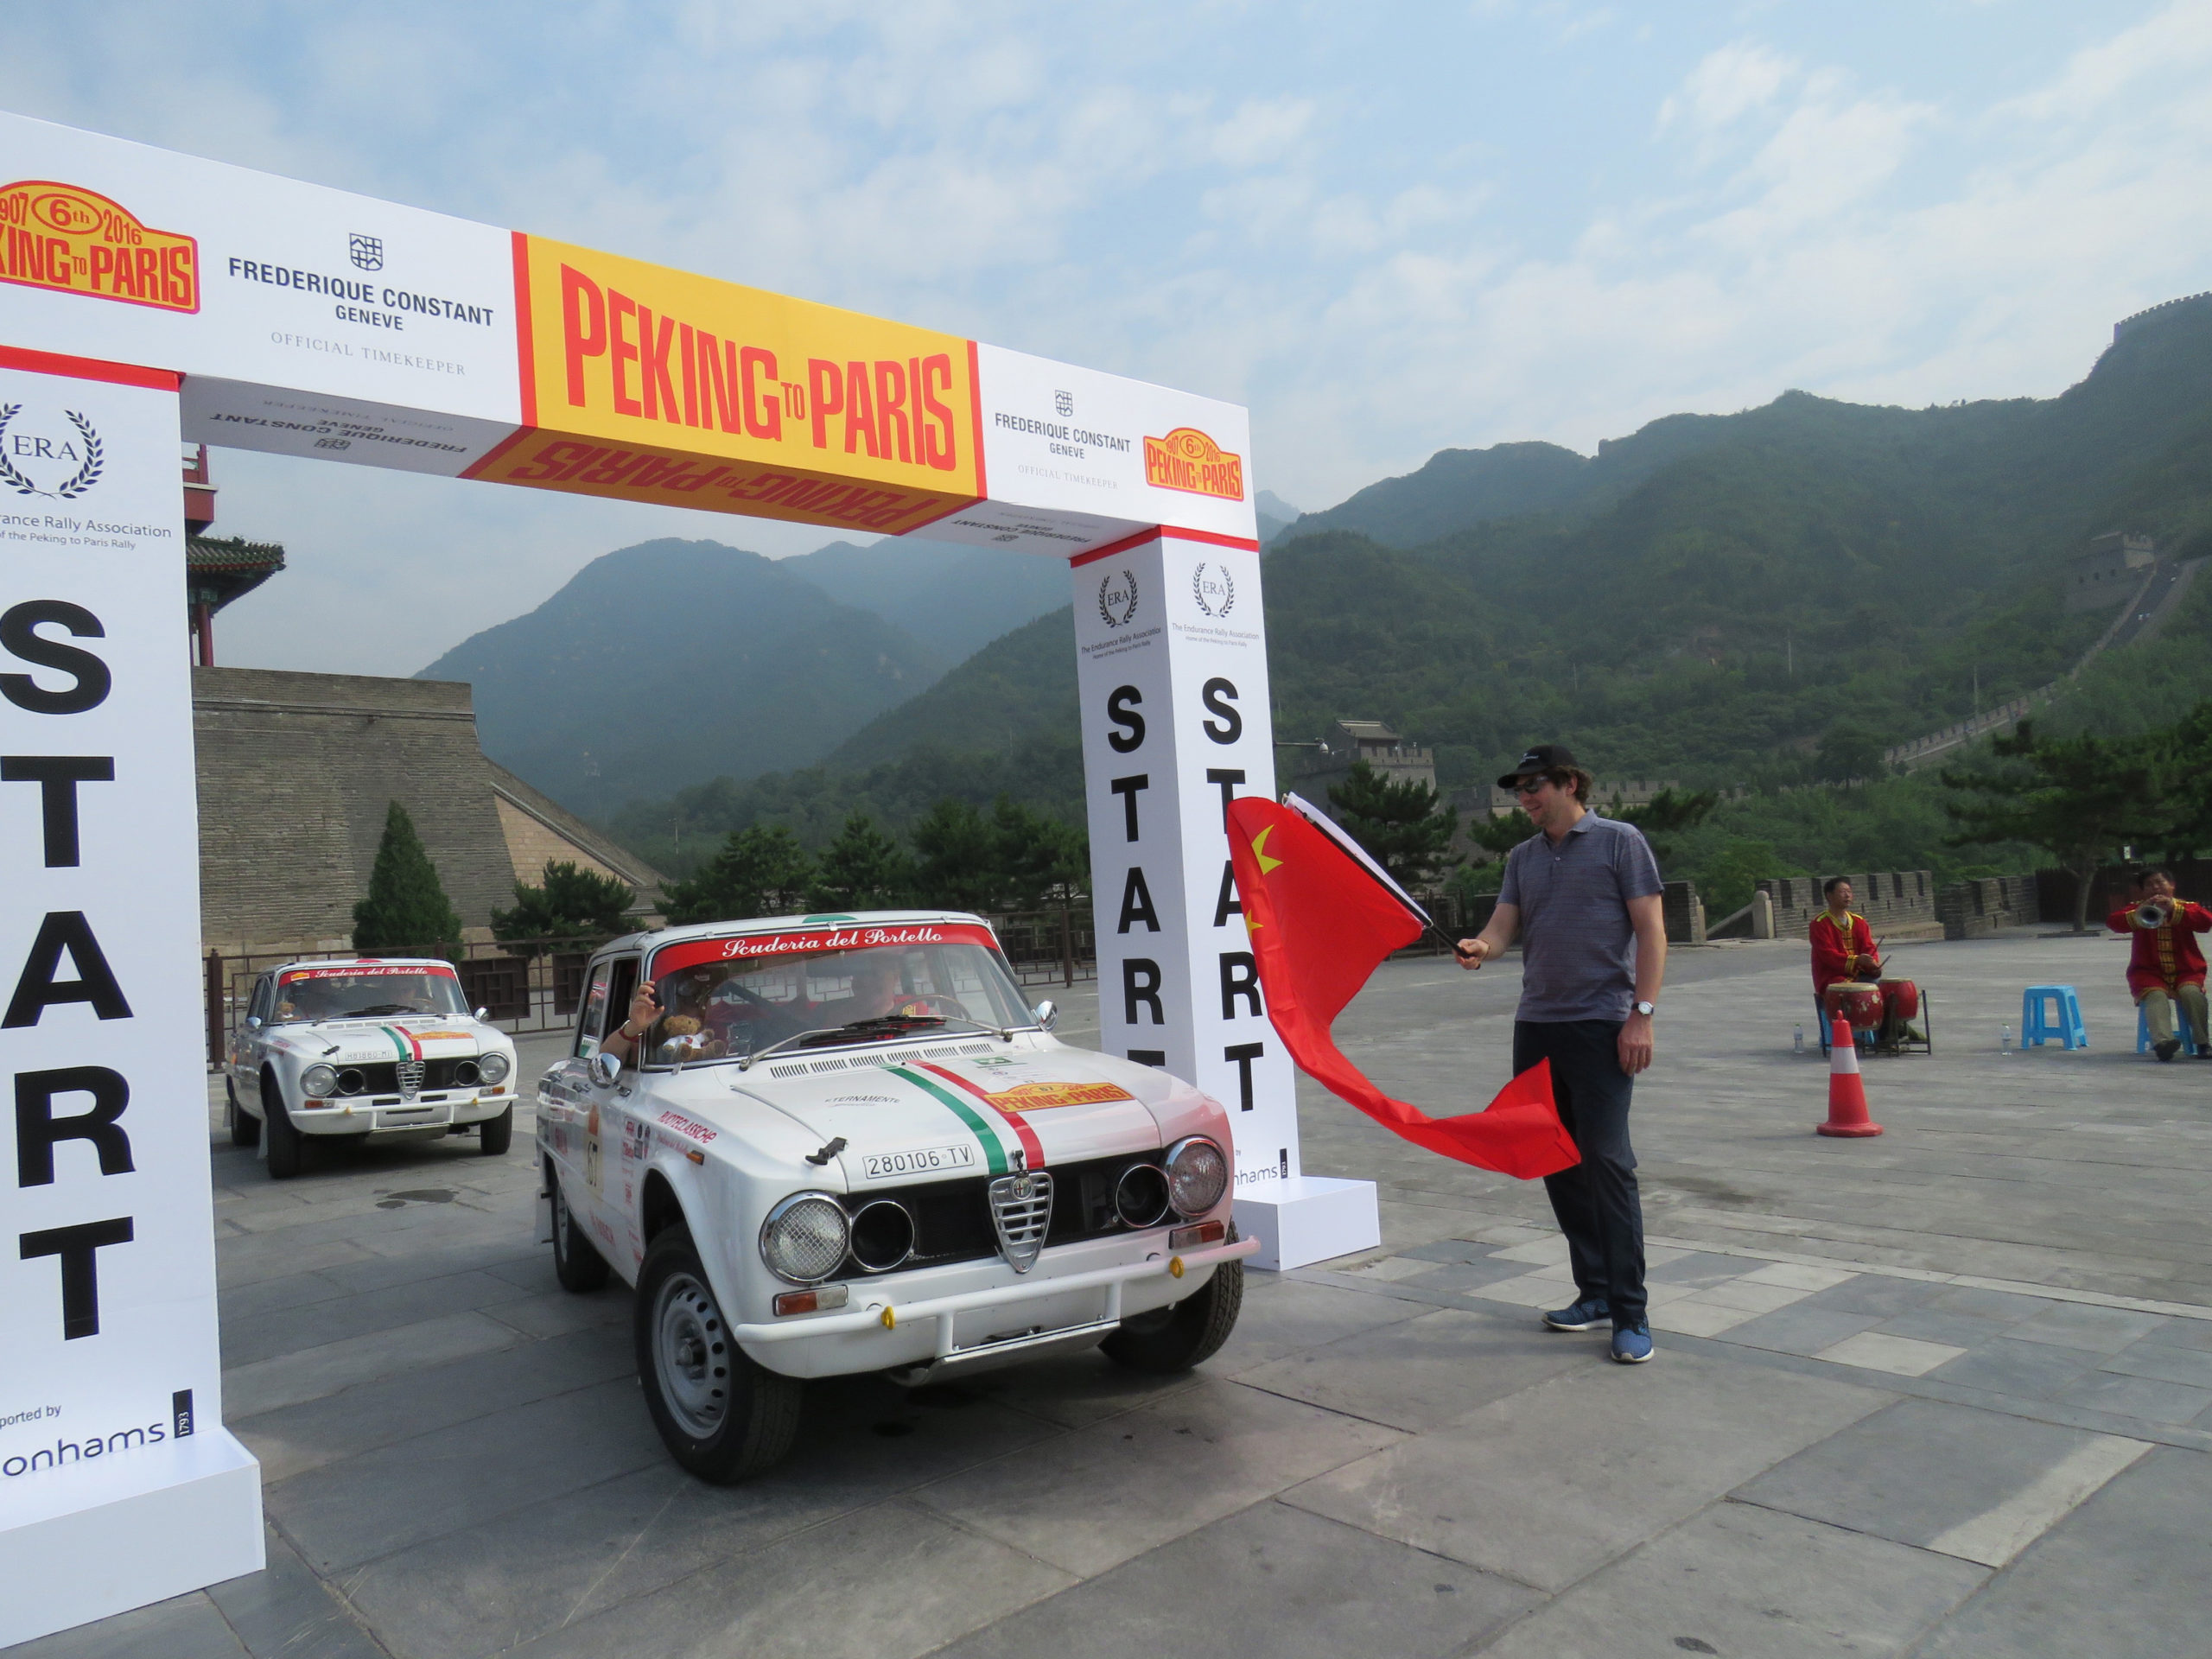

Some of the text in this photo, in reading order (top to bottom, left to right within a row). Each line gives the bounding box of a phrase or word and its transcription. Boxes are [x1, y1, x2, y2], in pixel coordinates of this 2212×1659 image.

[49, 199, 90, 226] 6th
[103, 208, 143, 245] 2016
[71, 256, 86, 276] TO
[90, 246, 191, 306] PARIS
[228, 257, 493, 327] FREDERIQUE CONSTANT
[335, 305, 404, 330] GENEVE
[271, 332, 466, 375] OFFICIAL TIMEKEEPER
[561, 263, 957, 472] PEKING TO PARIS
[209, 413, 467, 453] FREDERIQUE CONSTANT
[318, 419, 384, 433] GENEVE
[995, 412, 1131, 453] FREDERIQUE CONSTANT
[12, 434, 79, 461] ERA
[1050, 442, 1084, 459] GENEVE
[507, 441, 724, 493] PARIS
[1018, 464, 1118, 490] OFFICIAL TIMEKEEPER
[1147, 442, 1197, 489] PEKING
[1202, 461, 1241, 498] PARIS
[728, 474, 940, 529] PEKING
[0, 514, 172, 538] ance Rally Association
[9, 531, 27, 541] the
[30, 533, 67, 546] Peking
[70, 536, 81, 545] to
[84, 537, 109, 548] Paris
[111, 539, 137, 551] Rally
[1107, 589, 1130, 607] ERA
[1202, 580, 1226, 596] ERA
[1081, 645, 1090, 654] The
[1091, 639, 1118, 652] Endurance
[1119, 634, 1132, 644] Rally
[1172, 622, 1259, 640] The Endurance Rally Association
[722, 927, 944, 958] Scuderia del Portello
[0, 600, 137, 1341] START
[366, 967, 385, 976] del
[990, 1093, 1066, 1110] PEKING
[1068, 1085, 1126, 1103] PARIS
[868, 1147, 969, 1175] 280106 TV
[46, 1404, 61, 1418] by
[179, 1411, 190, 1436] 1793
